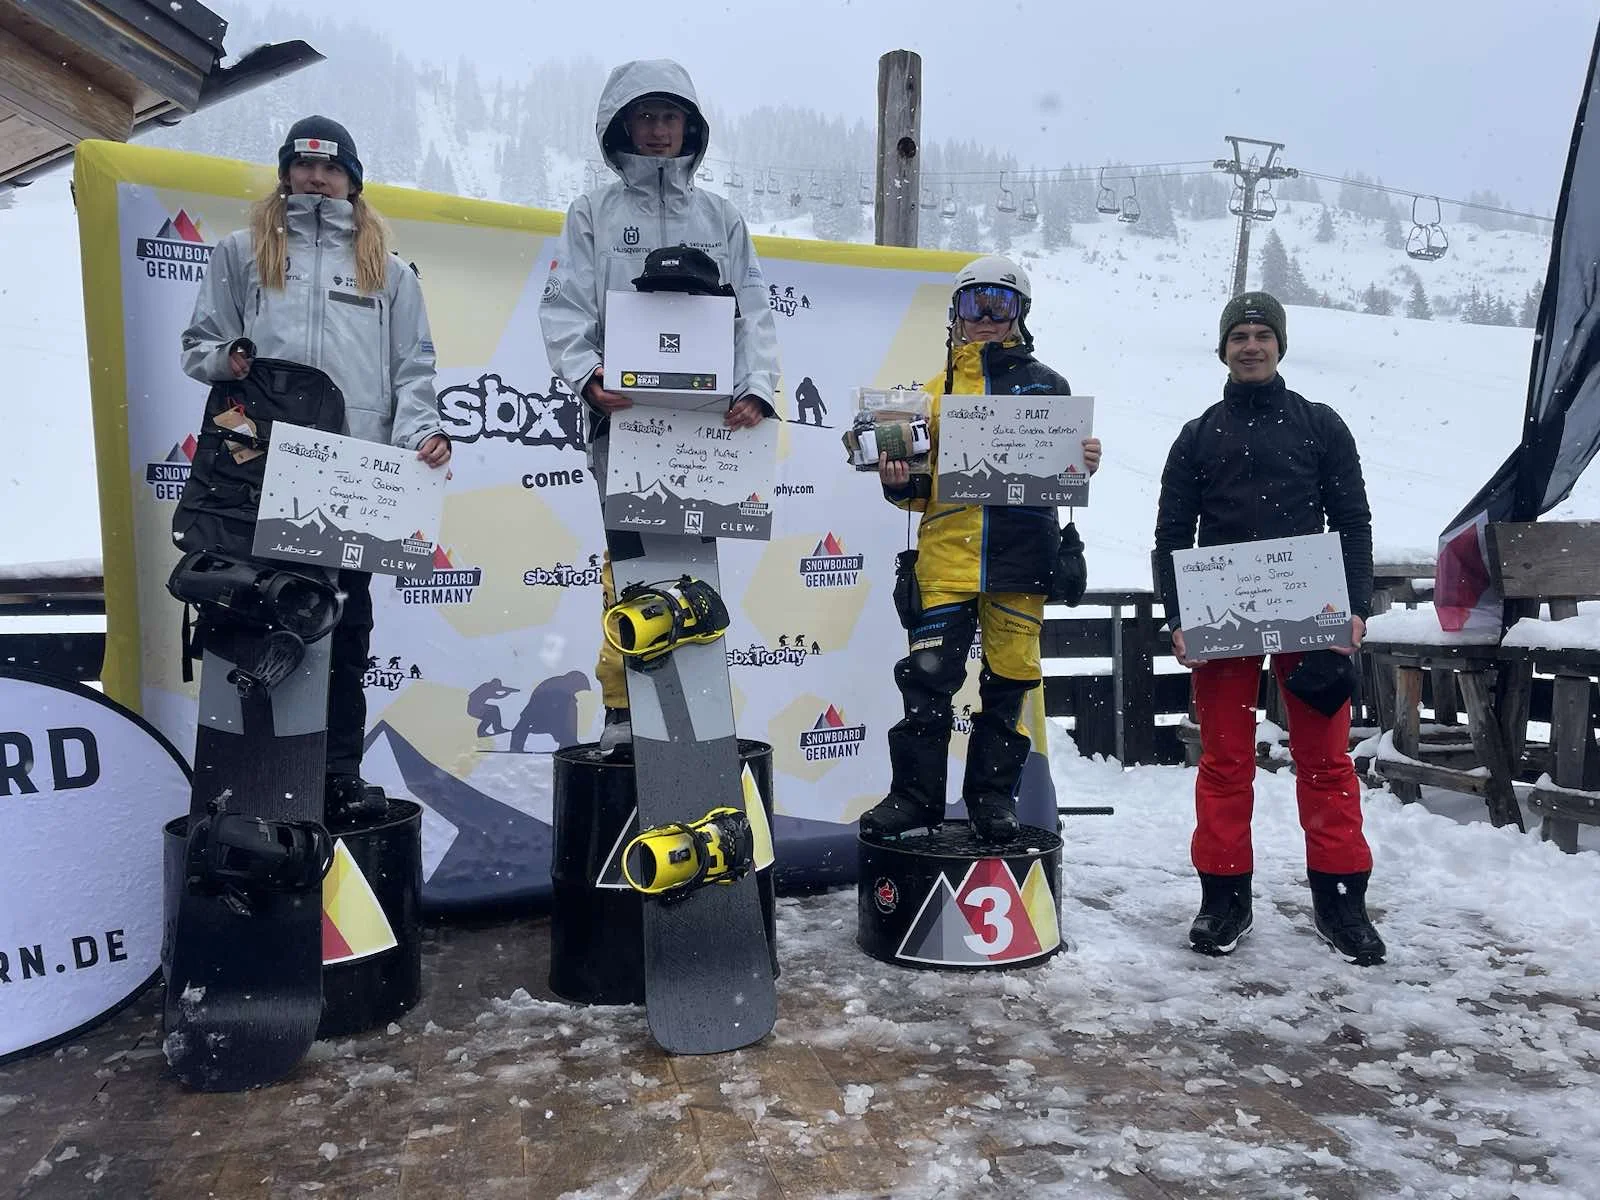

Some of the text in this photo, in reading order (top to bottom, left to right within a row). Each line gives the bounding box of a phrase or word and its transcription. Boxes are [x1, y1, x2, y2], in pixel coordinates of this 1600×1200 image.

[146, 242, 209, 261] SNOWBOA
[147, 261, 204, 282] GERMA
[1025, 409, 1049, 420] PLATZ
[706, 427, 732, 441] PLATZ
[373, 459, 401, 475] PLATZ
[718, 461, 739, 472] 2023
[521, 469, 584, 489] come
[774, 483, 814, 496] phy.com
[1041, 492, 1073, 501] CLEW
[377, 494, 399, 507] 2023
[721, 522, 755, 533] CLEW
[271, 543, 306, 555] Julbo
[381, 558, 417, 571] CLEW
[806, 556, 859, 571] SNOWBOARD
[1266, 551, 1293, 564] PLATZ
[404, 572, 474, 586] SNOWBOARD
[806, 572, 859, 588] GERMANY
[404, 588, 473, 605] GERMANY
[1300, 633, 1336, 645] CLEW
[806, 729, 861, 745] SNOWBOARD
[806, 743, 861, 761] GERMANY
[0, 727, 100, 796] RD
[963, 886, 1014, 955] 3
[0, 929, 128, 983] RN.DE
